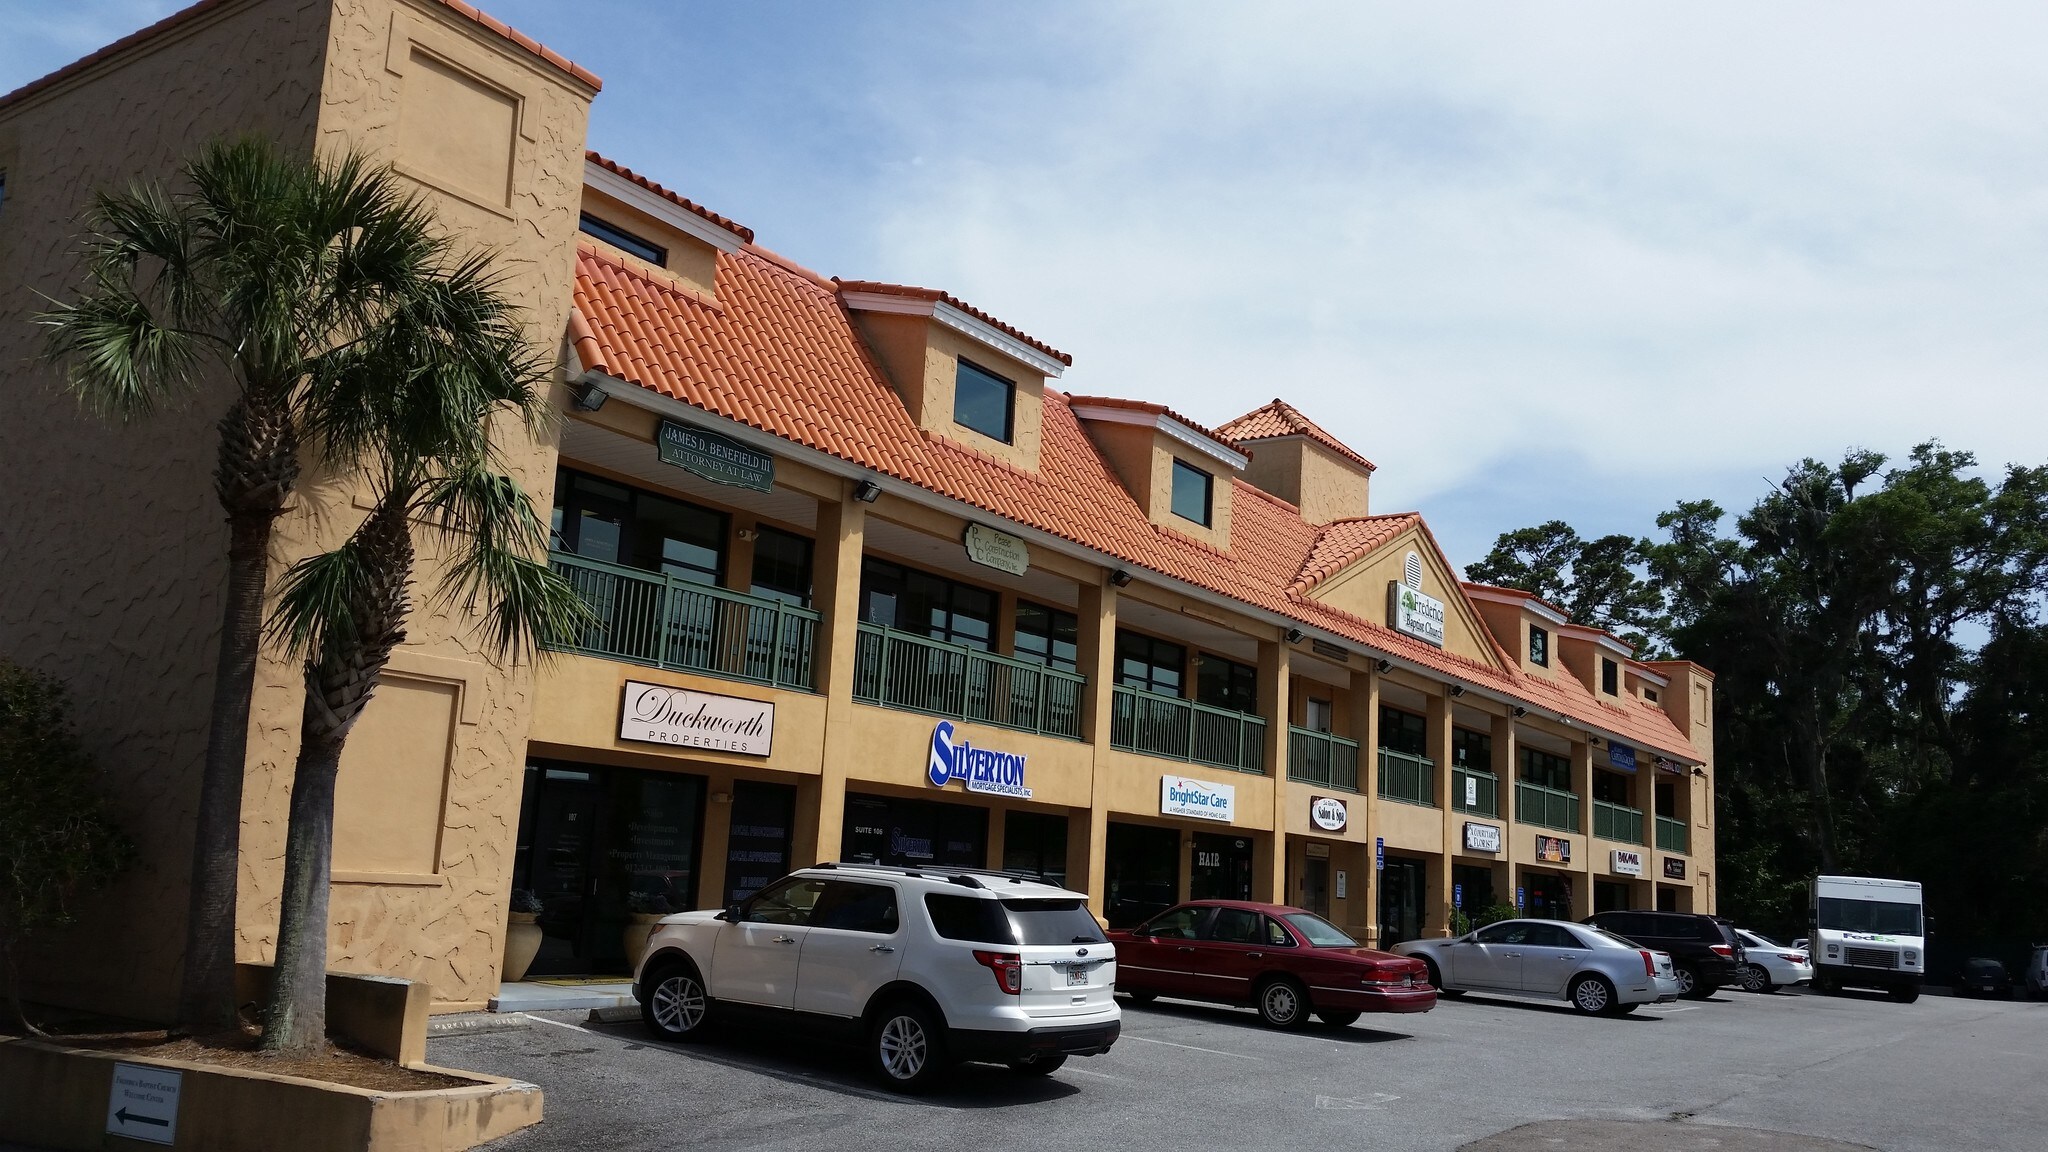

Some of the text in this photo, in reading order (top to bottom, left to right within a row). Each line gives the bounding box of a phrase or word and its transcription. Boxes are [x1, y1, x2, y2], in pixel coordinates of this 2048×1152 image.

[665, 427, 771, 472] JAMES D. BENEFIELD III
[671, 448, 763, 483] ATTORNEY AT LAW
[985, 541, 1020, 561] Construction
[1413, 593, 1444, 623] Frederica
[1406, 613, 1443, 640] Baptist Church
[630, 687, 766, 738] Duckworth
[648, 730, 749, 752] PROPERTIES
[971, 781, 997, 793] MORTGAGE
[1169, 787, 1228, 809] BrightStar Care
[1173, 807, 1186, 815] HIGHER
[1186, 808, 1204, 817] STANDARD
[855, 826, 872, 834] SUITE
[1474, 837, 1493, 849] FLORIST
[1198, 852, 1220, 867] HAIR
[1843, 932, 1897, 943] FedEx
